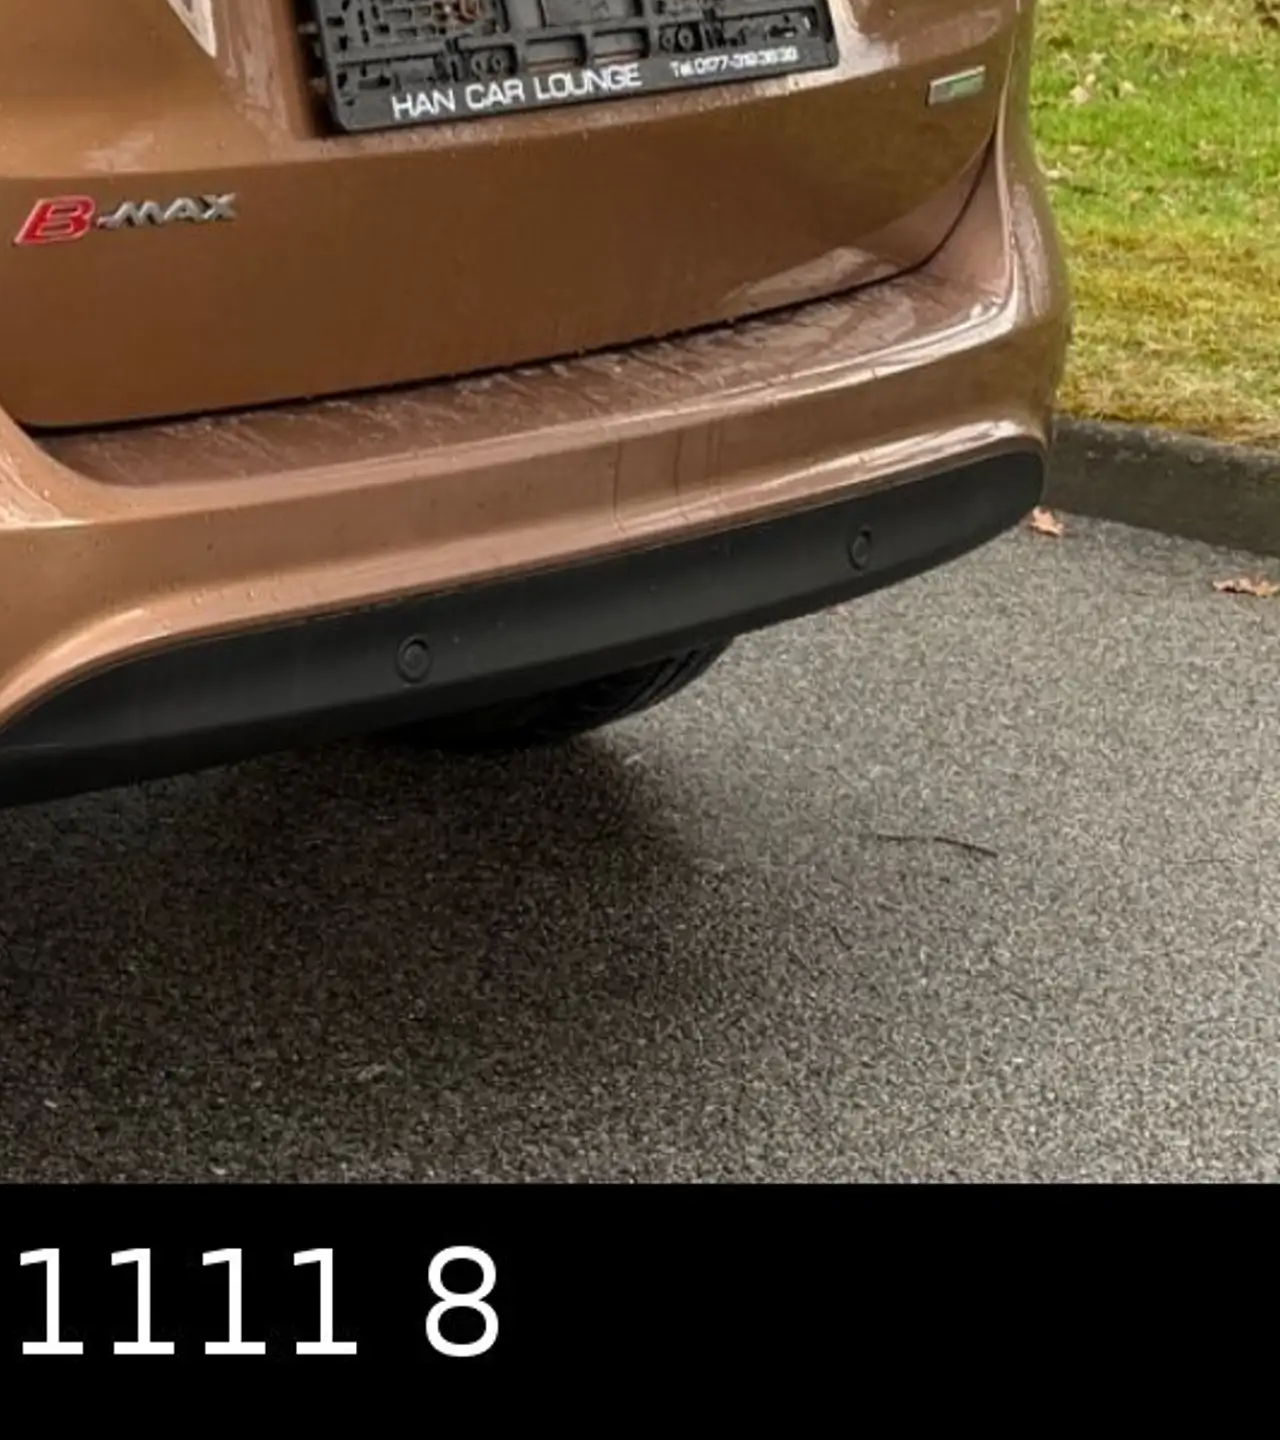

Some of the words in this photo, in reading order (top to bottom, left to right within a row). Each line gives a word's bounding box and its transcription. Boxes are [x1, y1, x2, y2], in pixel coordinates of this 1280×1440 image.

[391, 88, 456, 121] HAN
[464, 78, 526, 110] CAR
[532, 62, 643, 101] LOUNGE
[13, 192, 237, 245] B-MAX
